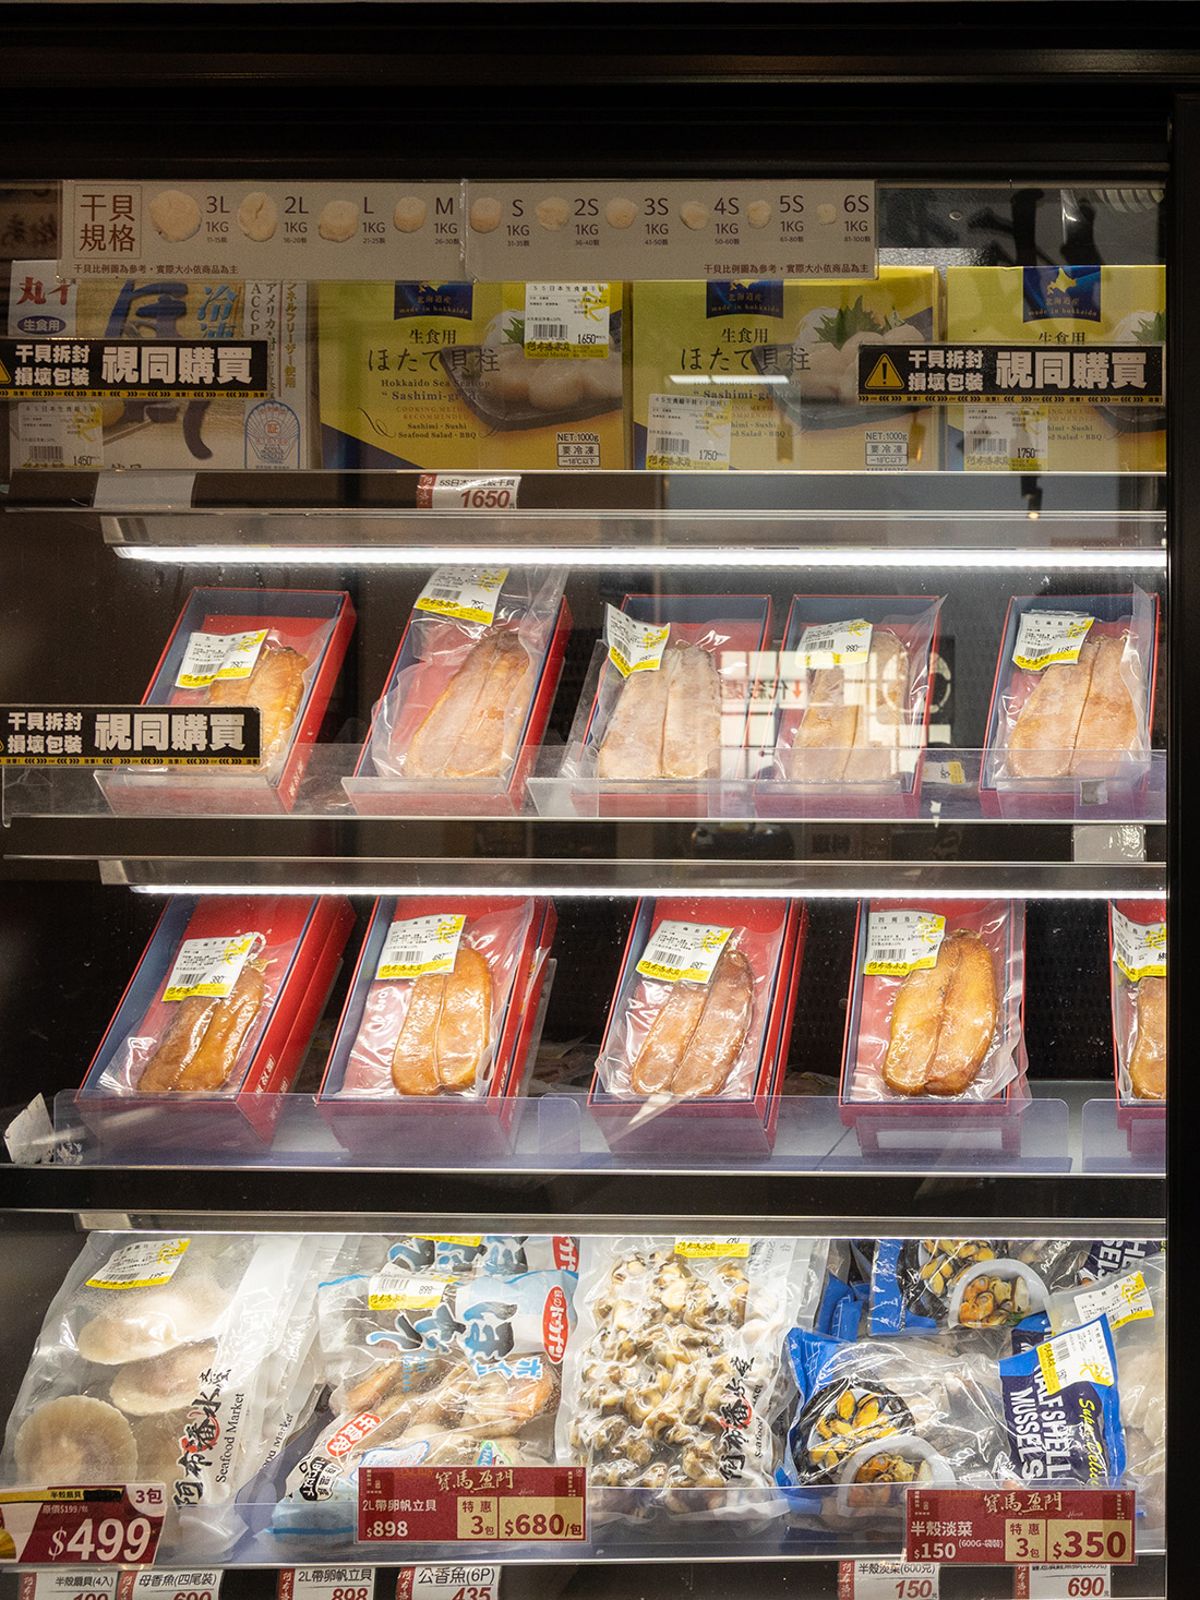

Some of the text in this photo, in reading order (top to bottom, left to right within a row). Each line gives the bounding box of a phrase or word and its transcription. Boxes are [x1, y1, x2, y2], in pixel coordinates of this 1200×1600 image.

[80, 193, 135, 222] 干貝
[206, 196, 230, 214] 3L
[284, 196, 309, 214] 2L
[363, 196, 374, 214] L
[435, 197, 454, 215] M
[512, 199, 524, 217] S
[574, 199, 599, 217] 2S
[644, 198, 669, 216] 3S
[714, 197, 740, 216] 4S
[780, 195, 805, 213] 5S
[844, 195, 870, 213] 6S
[206, 222, 229, 233] 1KG
[284, 222, 308, 233] 1KG
[362, 222, 386, 234] 1KG
[434, 222, 458, 235] 1KG
[506, 225, 530, 236] 1KG
[575, 225, 599, 236] 1KG
[646, 224, 669, 235] 1KG
[715, 223, 739, 234] 1KG
[781, 221, 804, 232] 1KG
[845, 221, 868, 232] 1KG
[79, 224, 135, 252] 規格
[409, 329, 457, 345] 生食用
[722, 328, 768, 343] 生食用
[15, 344, 90, 364] 干貝拆封
[368, 348, 501, 372] ほたて貝柱
[681, 347, 811, 371] ほたて貝柱
[908, 349, 984, 370] 干貝拆封
[102, 346, 252, 385] 視同購買
[996, 351, 1147, 390] 視同購買
[15, 367, 90, 387] 損壞包裝
[381, 379, 450, 388] Hokkaido Sea
[908, 372, 984, 392] 損壞包裝
[557, 432, 600, 443] NET:1000g
[865, 431, 908, 443] NET:1000g
[461, 490, 511, 509] 1650
[8, 712, 83, 732] 干貝拆封
[94, 713, 246, 752] 視同購買
[8, 735, 83, 754] 損壞包裝
[216, 1393, 245, 1484] Seafood Market
[1009, 1386, 1044, 1479] MUSSELS
[136, 1489, 163, 1505] 3包
[363, 1499, 437, 1513] 2L帶卵帆立貝
[462, 1500, 492, 1513] 特惠
[367, 1520, 408, 1538] $898
[470, 1516, 495, 1536] 3包
[505, 1513, 582, 1538] $680/包
[911, 1520, 973, 1537] 半殼淡菜
[1010, 1523, 1040, 1536] 特惠
[49, 1517, 150, 1561] $499
[1017, 1537, 1040, 1558] 3包
[1053, 1530, 1127, 1559] $350
[914, 1543, 956, 1559] $150
[139, 1572, 217, 1587] 母香魚(四尾裝)
[298, 1568, 372, 1583] 2L帶卵帆立貝
[419, 1567, 495, 1585] 公香魚(6P)
[895, 1579, 932, 1599] 150
[1067, 1577, 1104, 1596] 690
